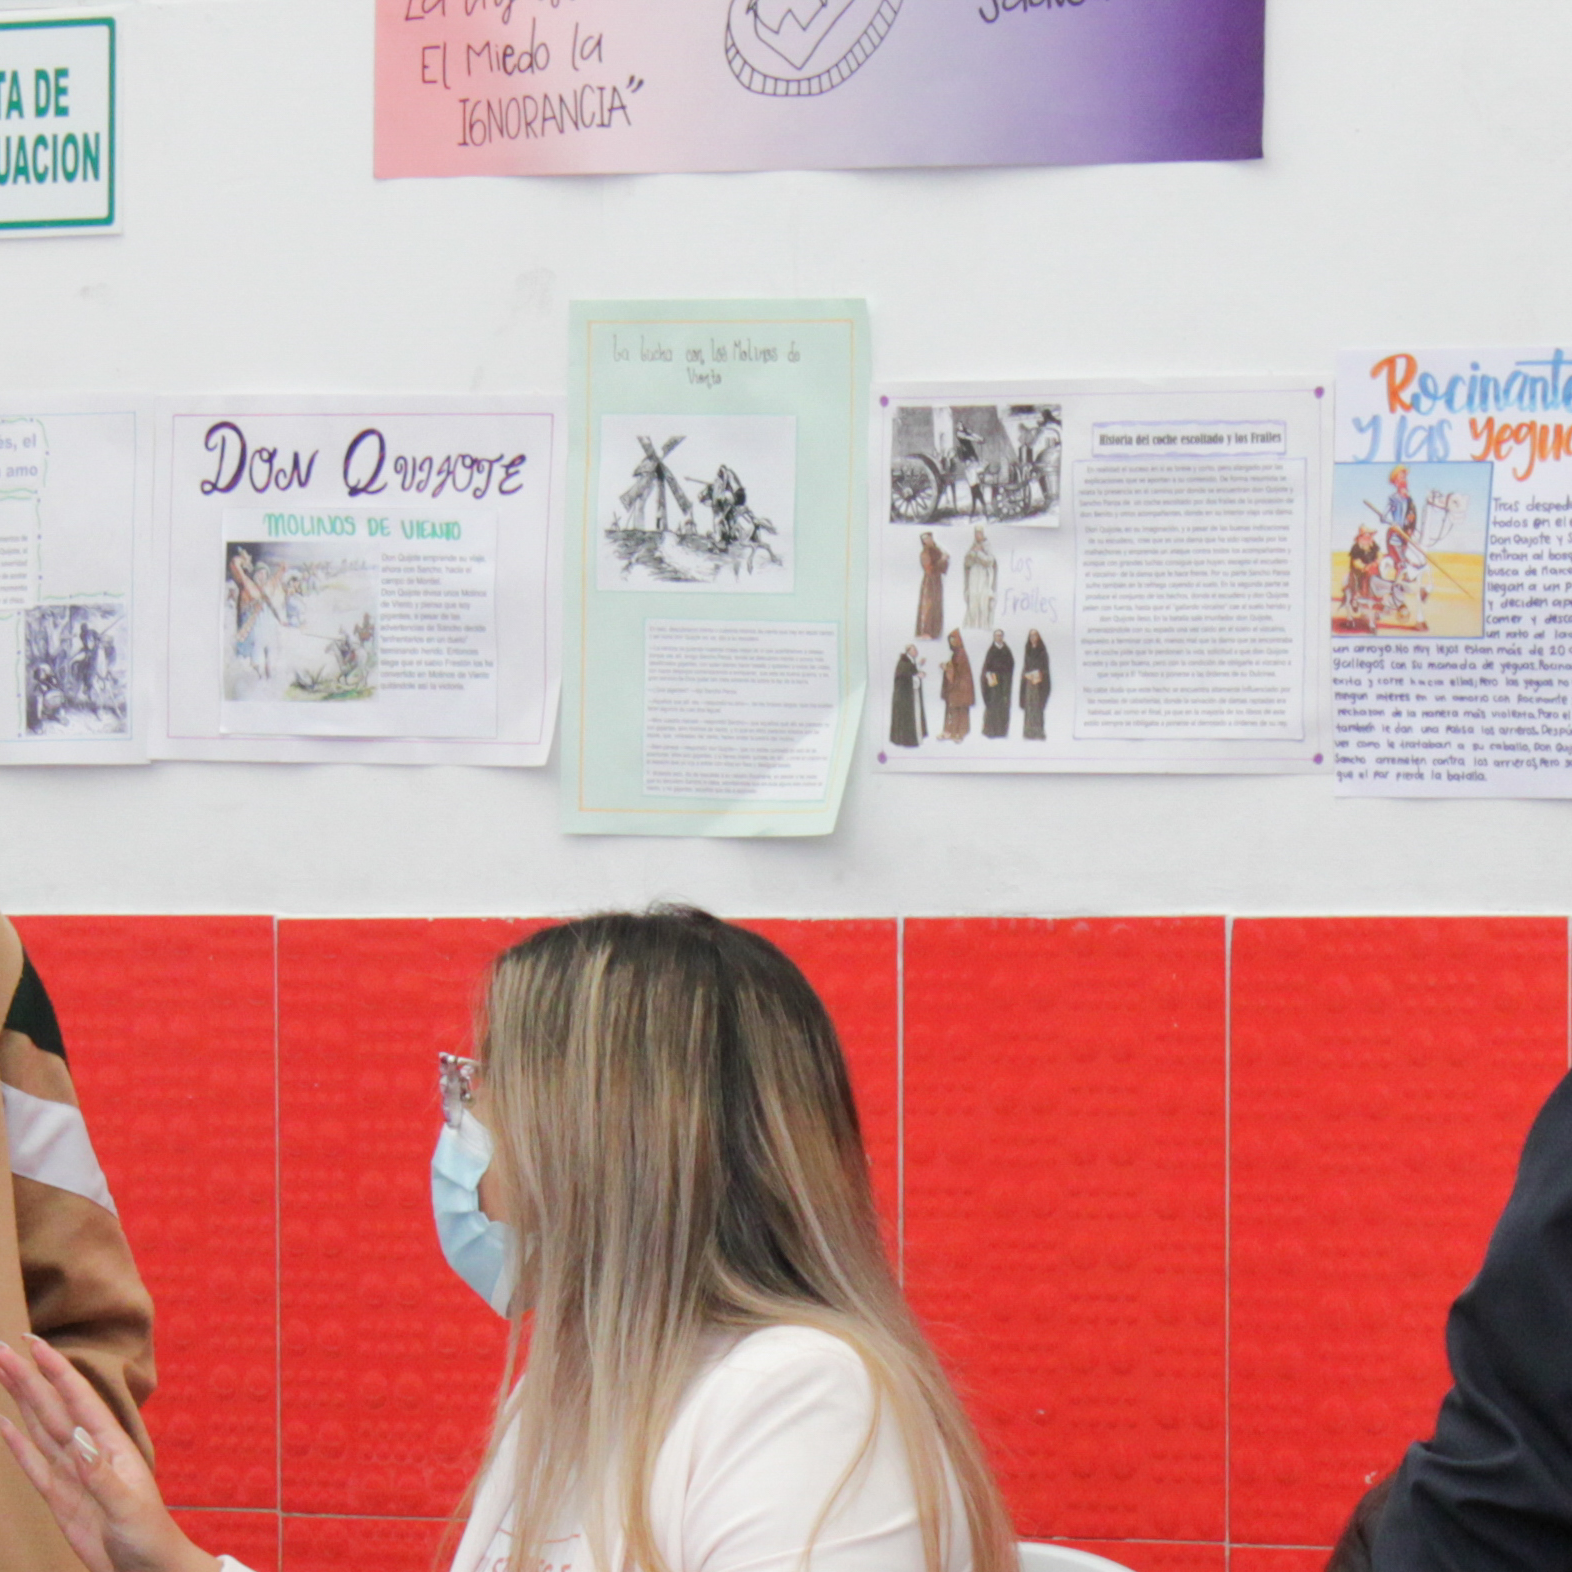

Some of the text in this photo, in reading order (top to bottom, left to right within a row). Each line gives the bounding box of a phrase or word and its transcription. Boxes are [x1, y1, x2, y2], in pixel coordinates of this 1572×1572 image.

[422, 16, 603, 90] El Miedo la
[35, 67, 69, 118] DE
[23, 433, 37, 450] el
[1099, 434, 1133, 446] Historia
[1136, 433, 1149, 446] del
[1152, 433, 1178, 445] coche
[1181, 433, 1224, 445] escoltado
[1235, 432, 1248, 444] los
[1251, 432, 1282, 444] Frailes
[1396, 415, 1452, 462] las
[5, 465, 38, 478] amo
[1493, 497, 1520, 512] Tras
[263, 513, 461, 541] MOLINOS DE VIENTO
[1492, 518, 1528, 528] todos
[1533, 518, 1550, 530] en
[1555, 516, 1566, 528] el
[1490, 535, 1511, 546] Don
[1489, 548, 1528, 562] entran
[1532, 550, 1544, 561] al
[1487, 565, 1519, 577] busca
[1524, 564, 1537, 576] de
[1487, 581, 1524, 597] llegan
[1528, 583, 1537, 591] a
[1543, 583, 1560, 592] un
[1500, 596, 1548, 609] deciden
[1486, 630, 1500, 639] un
[1534, 629, 1545, 639] al
[1333, 658, 1385, 673] gallegos
[1391, 660, 1406, 670] con
[1412, 660, 1423, 670] su
[1427, 658, 1477, 670] manada
[1482, 659, 1494, 670] de
